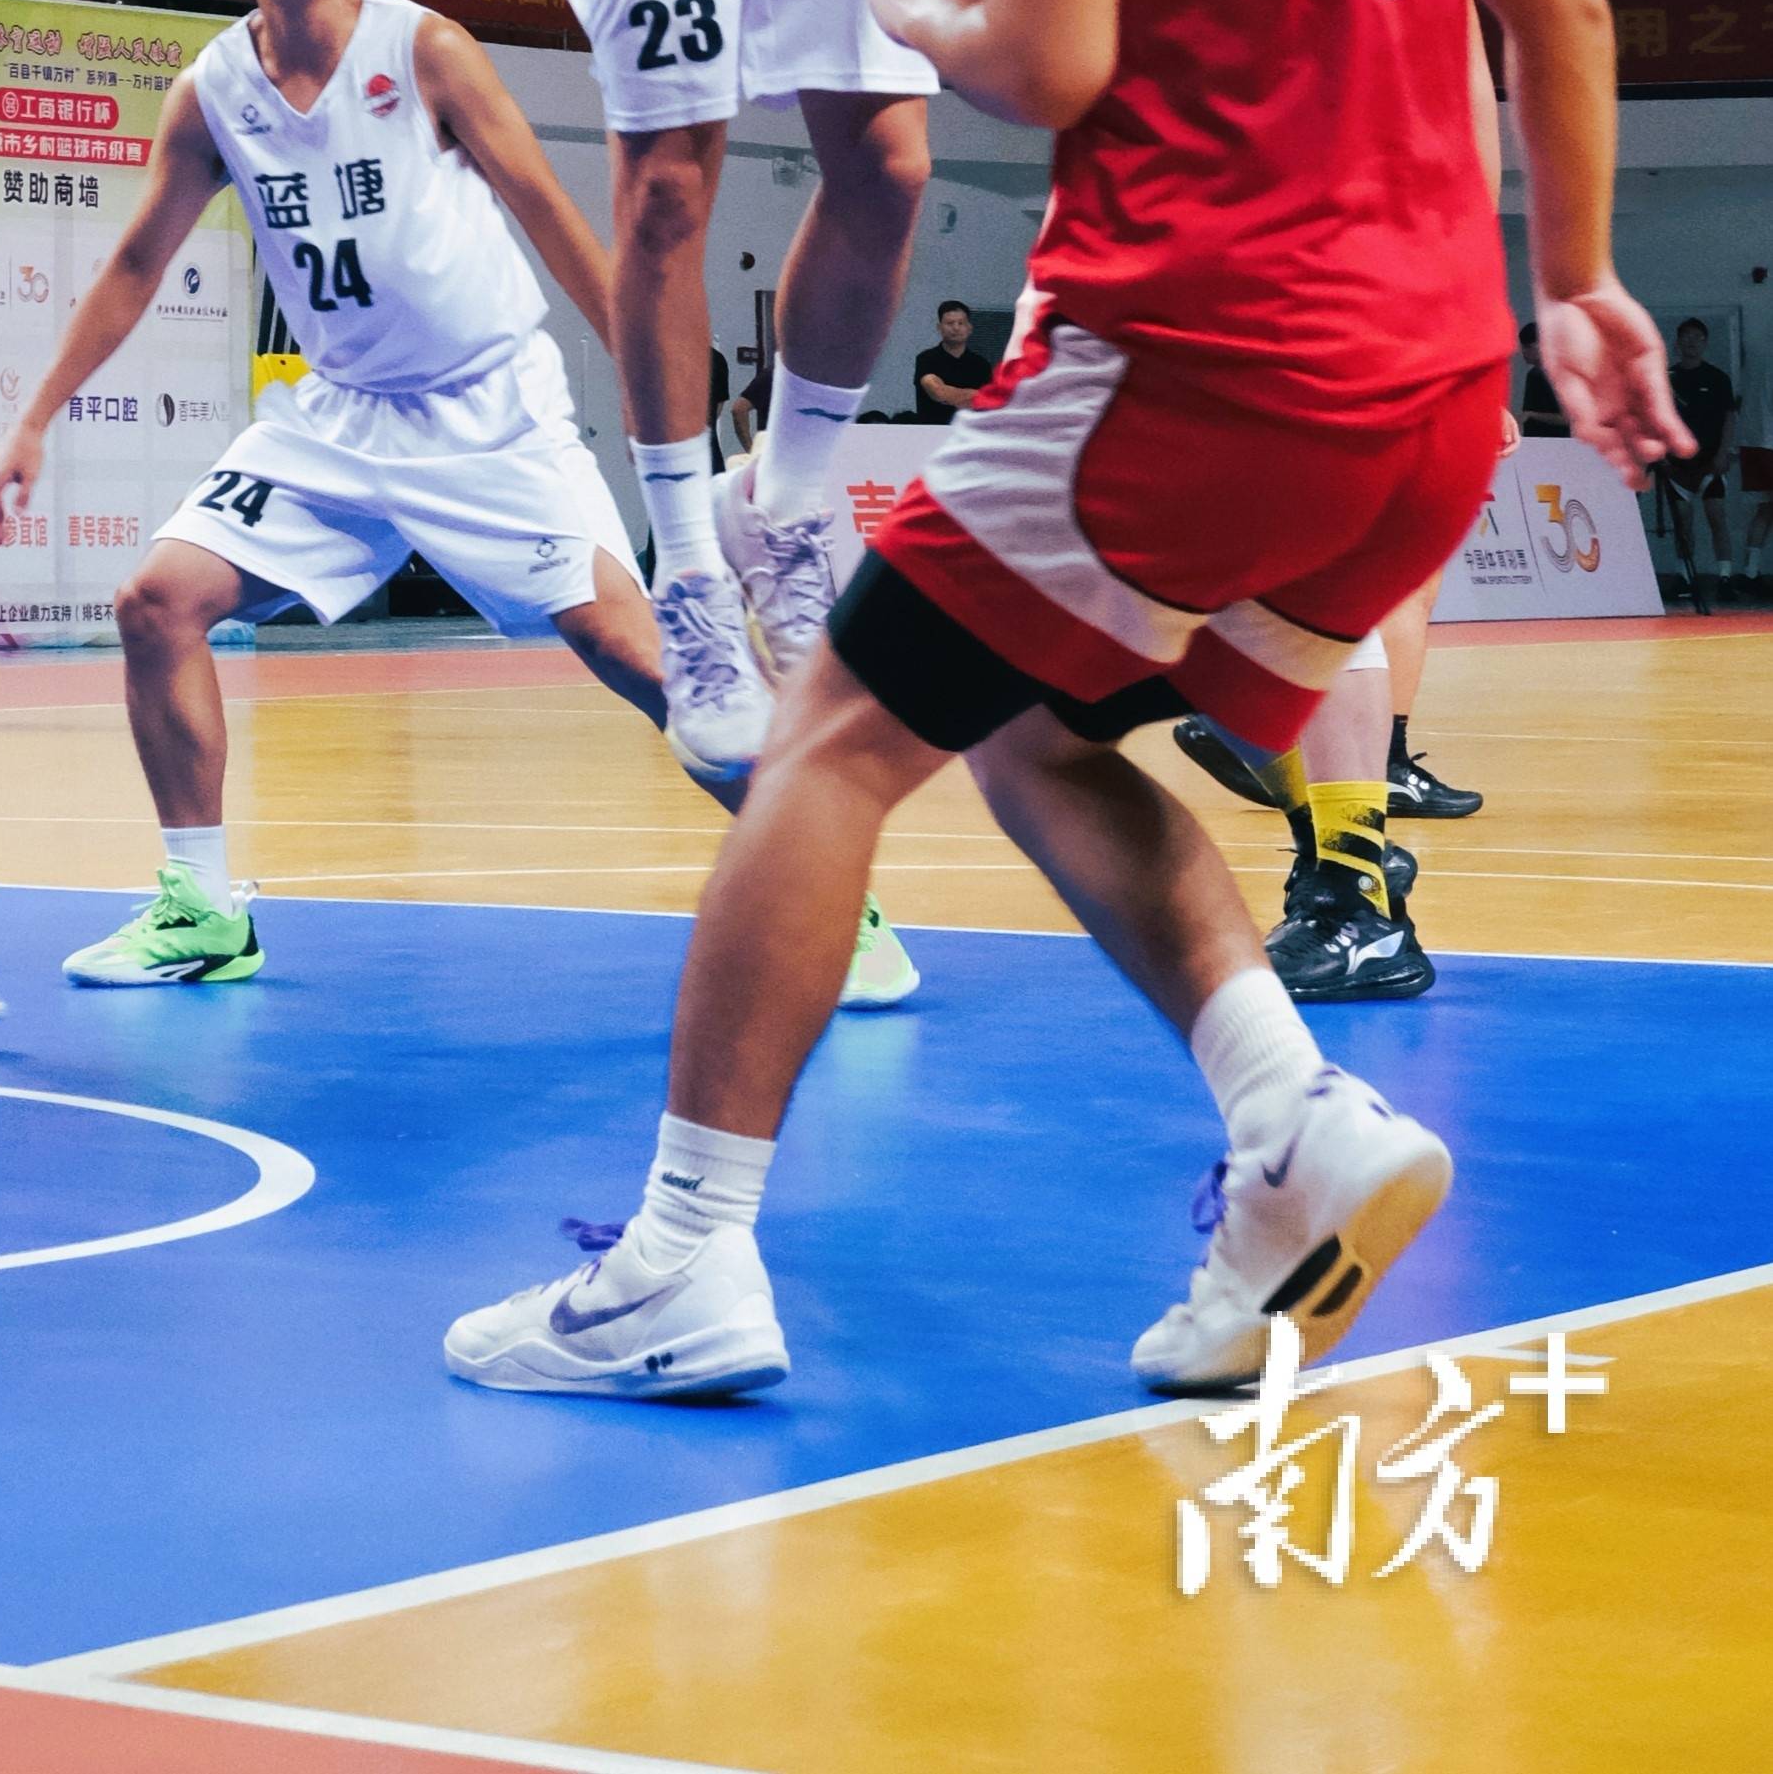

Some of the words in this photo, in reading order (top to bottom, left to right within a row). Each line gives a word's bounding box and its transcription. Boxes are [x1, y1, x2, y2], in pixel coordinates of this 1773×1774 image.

[20, 94, 112, 124] 工商银行杯
[2, 168, 100, 210] 赞助商墙
[254, 158, 386, 230] 蓝塘
[293, 238, 375, 313] 24
[196, 469, 275, 528] 24
[68, 516, 139, 548] 壹号寄卖行
[1535, 484, 1601, 573] 30
